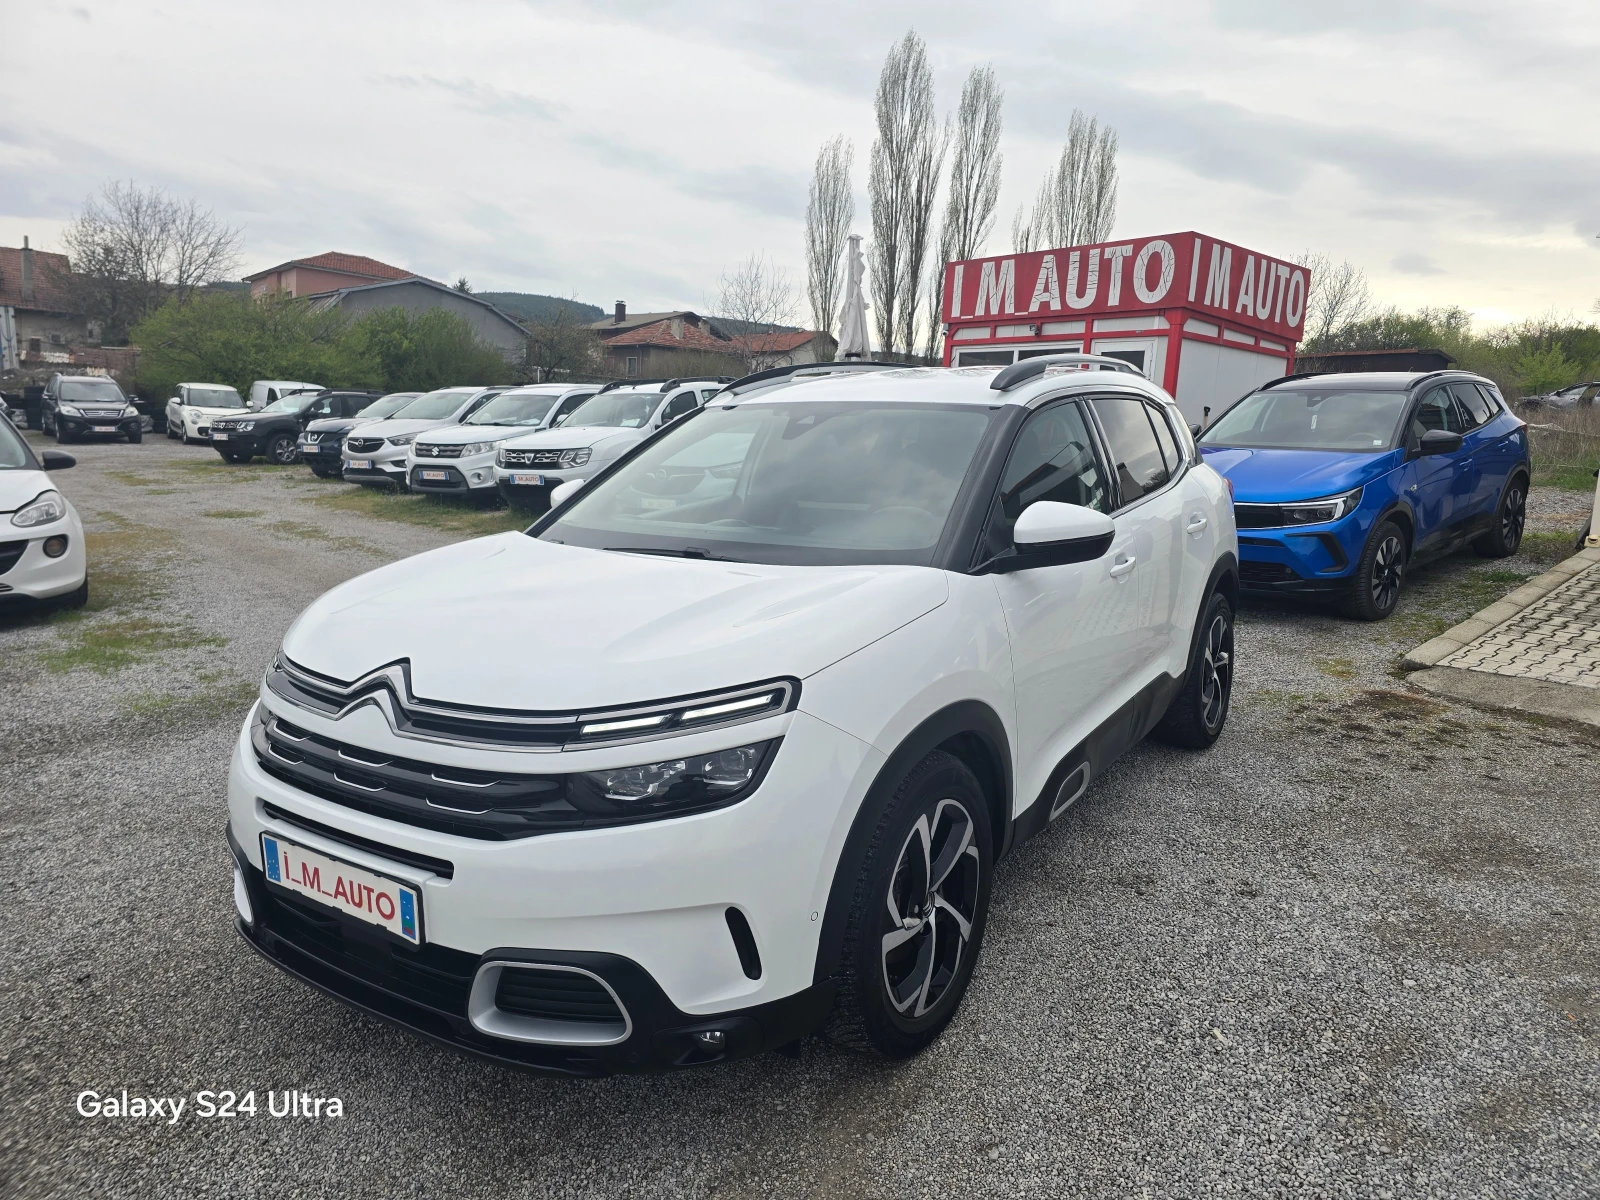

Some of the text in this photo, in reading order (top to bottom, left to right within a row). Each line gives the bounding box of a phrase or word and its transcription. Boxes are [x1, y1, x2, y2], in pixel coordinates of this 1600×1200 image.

[1188, 238, 1305, 328] I M AUTO
